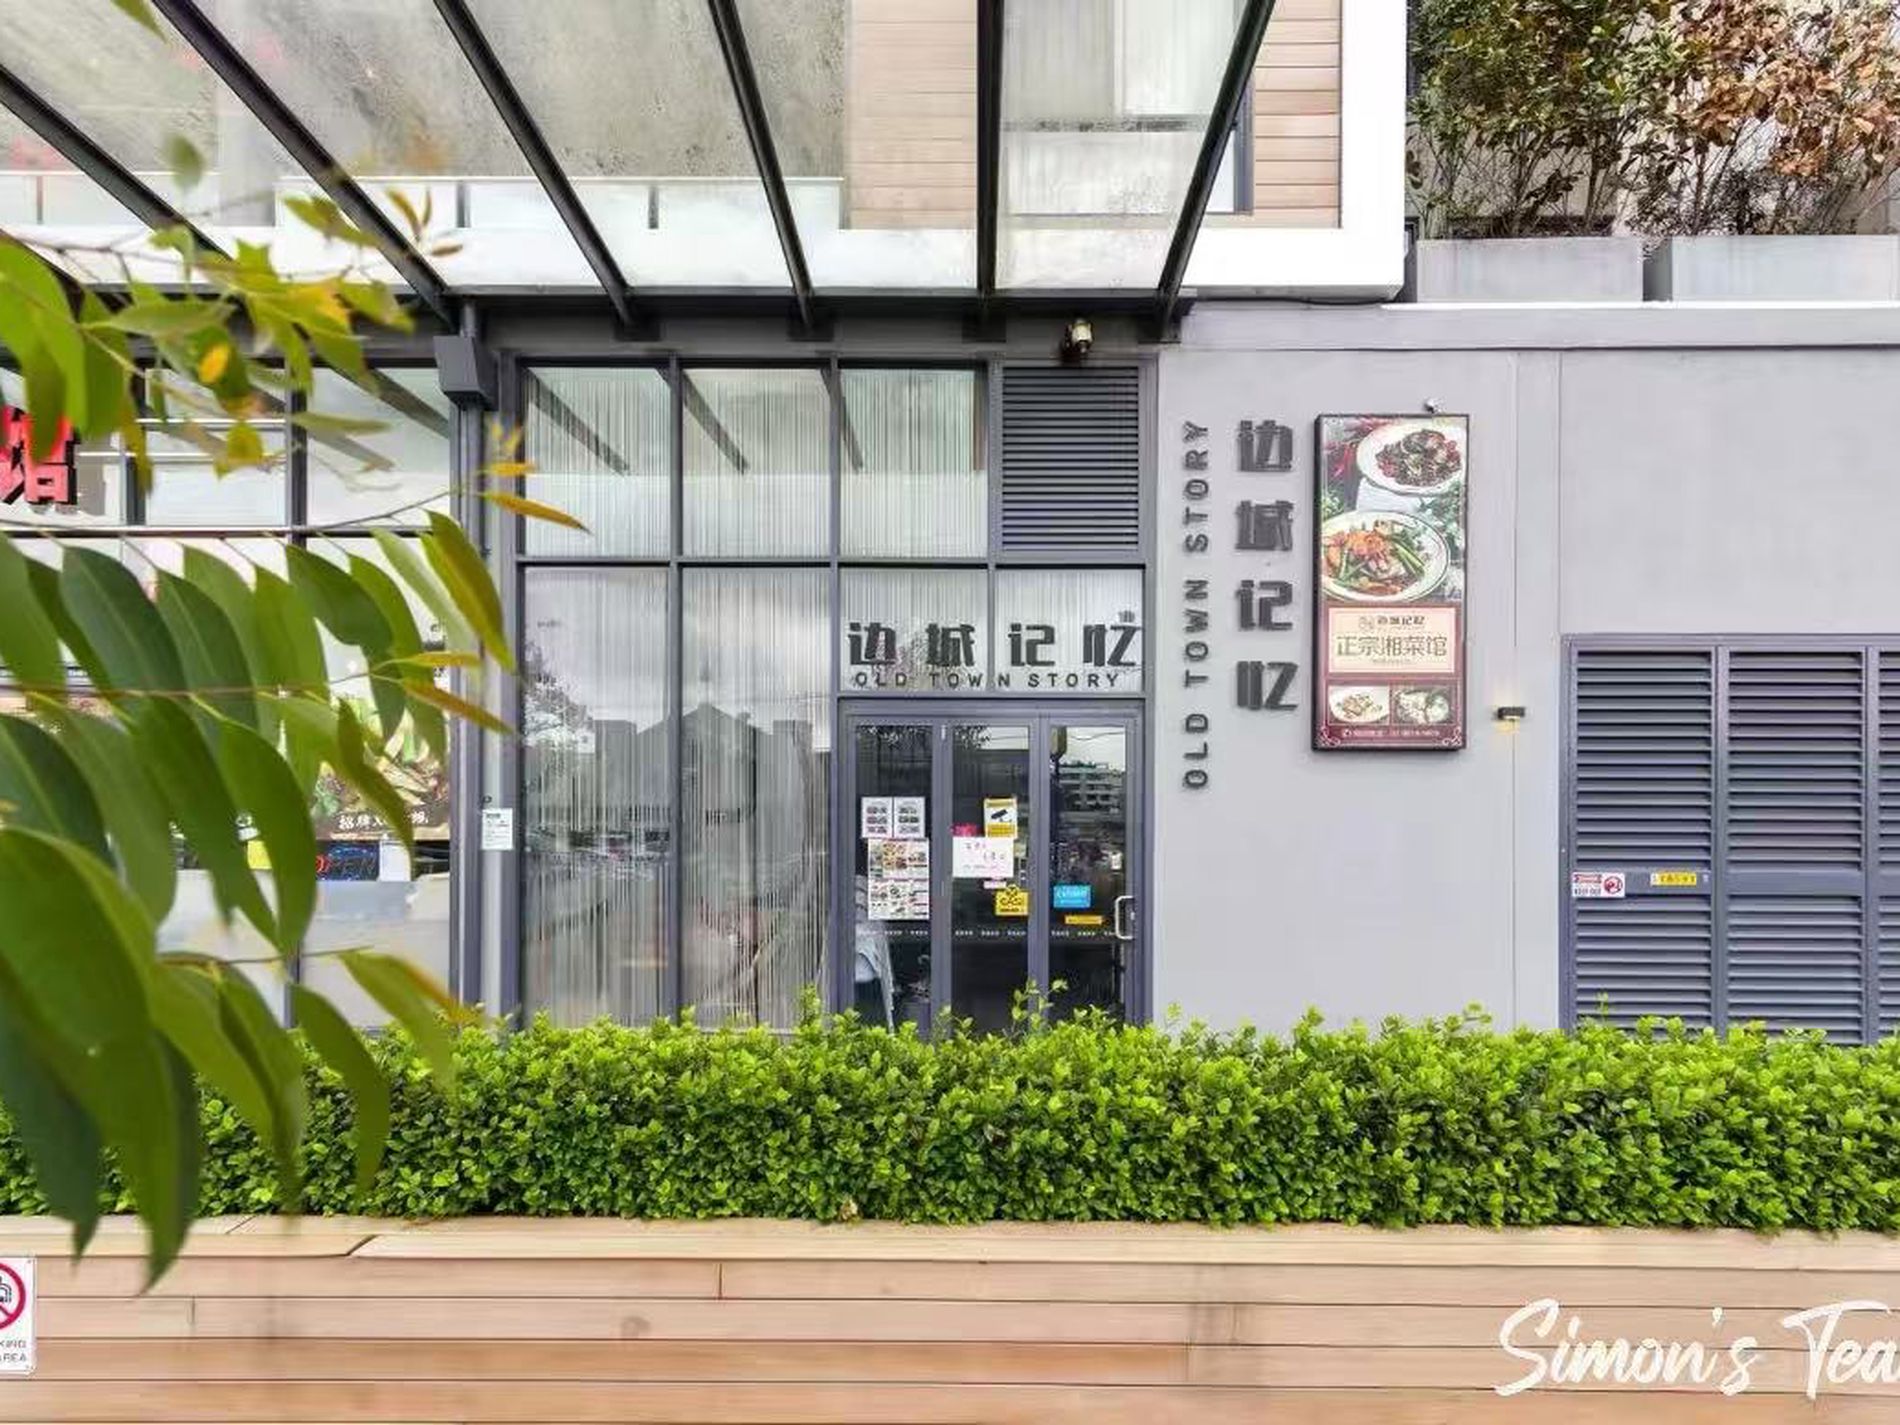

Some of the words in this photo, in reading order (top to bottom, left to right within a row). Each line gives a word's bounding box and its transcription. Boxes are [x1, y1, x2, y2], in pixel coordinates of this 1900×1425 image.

[1183, 420, 1209, 553] STORY
[1235, 420, 1298, 712] 边城记忆
[848, 622, 1142, 667] 边城记忆
[1183, 579, 1208, 690] TOWN
[1336, 635, 1448, 658] 正宗湘菜馆
[855, 672, 908, 688] OLD
[929, 672, 1011, 688] TOWN
[1027, 672, 1119, 688] STORY
[1183, 712, 1208, 790] OLD
